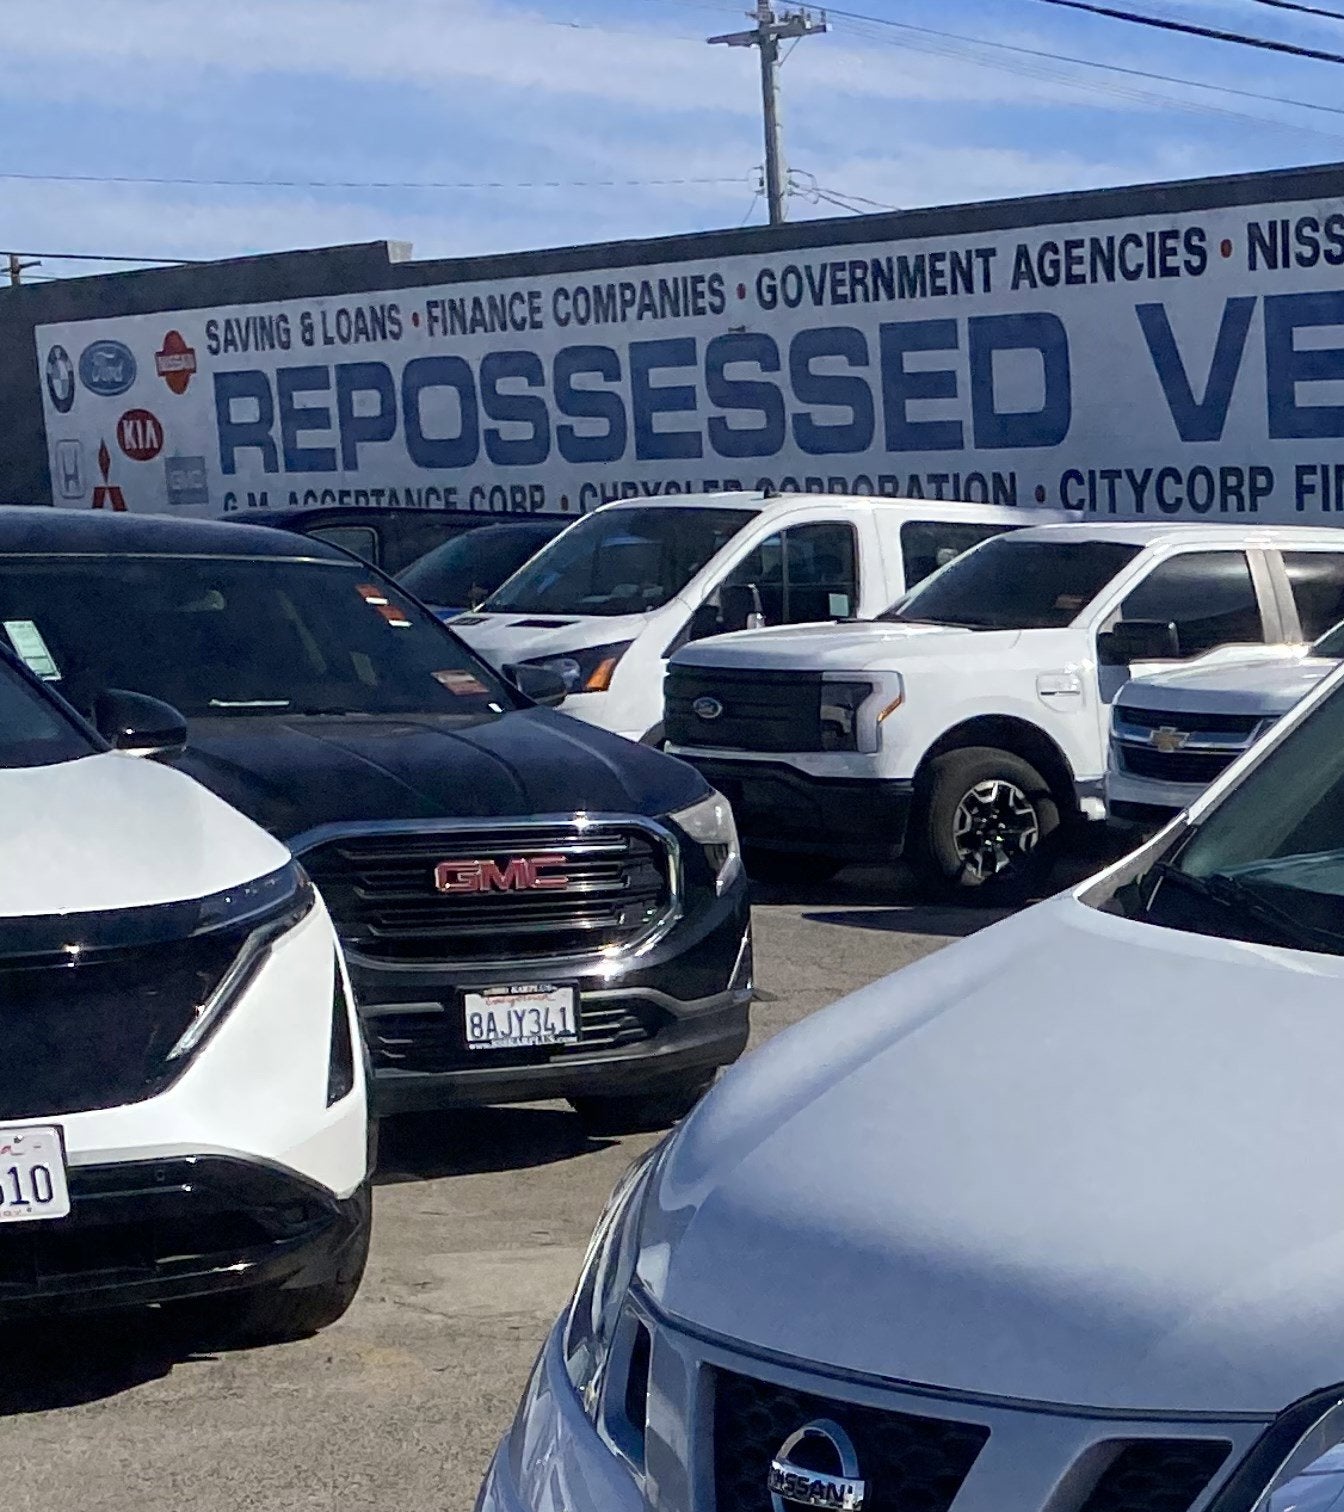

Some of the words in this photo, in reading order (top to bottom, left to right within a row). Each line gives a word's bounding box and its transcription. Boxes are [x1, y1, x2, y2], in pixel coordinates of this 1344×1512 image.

[205, 313, 291, 355] SAVING
[300, 311, 314, 347] &
[321, 304, 402, 346] LOANS
[426, 291, 543, 337] FINANCE
[553, 273, 726, 328] COMPANIES
[755, 247, 997, 310] GOVERNMENT
[1011, 226, 1208, 291] AGENCIES
[213, 312, 1071, 475] REPOSSESSED
[121, 419, 159, 450] KIA
[1059, 466, 1273, 513] CITYCORP
[434, 854, 568, 893] GMC
[470, 1006, 573, 1040] 8AJY341
